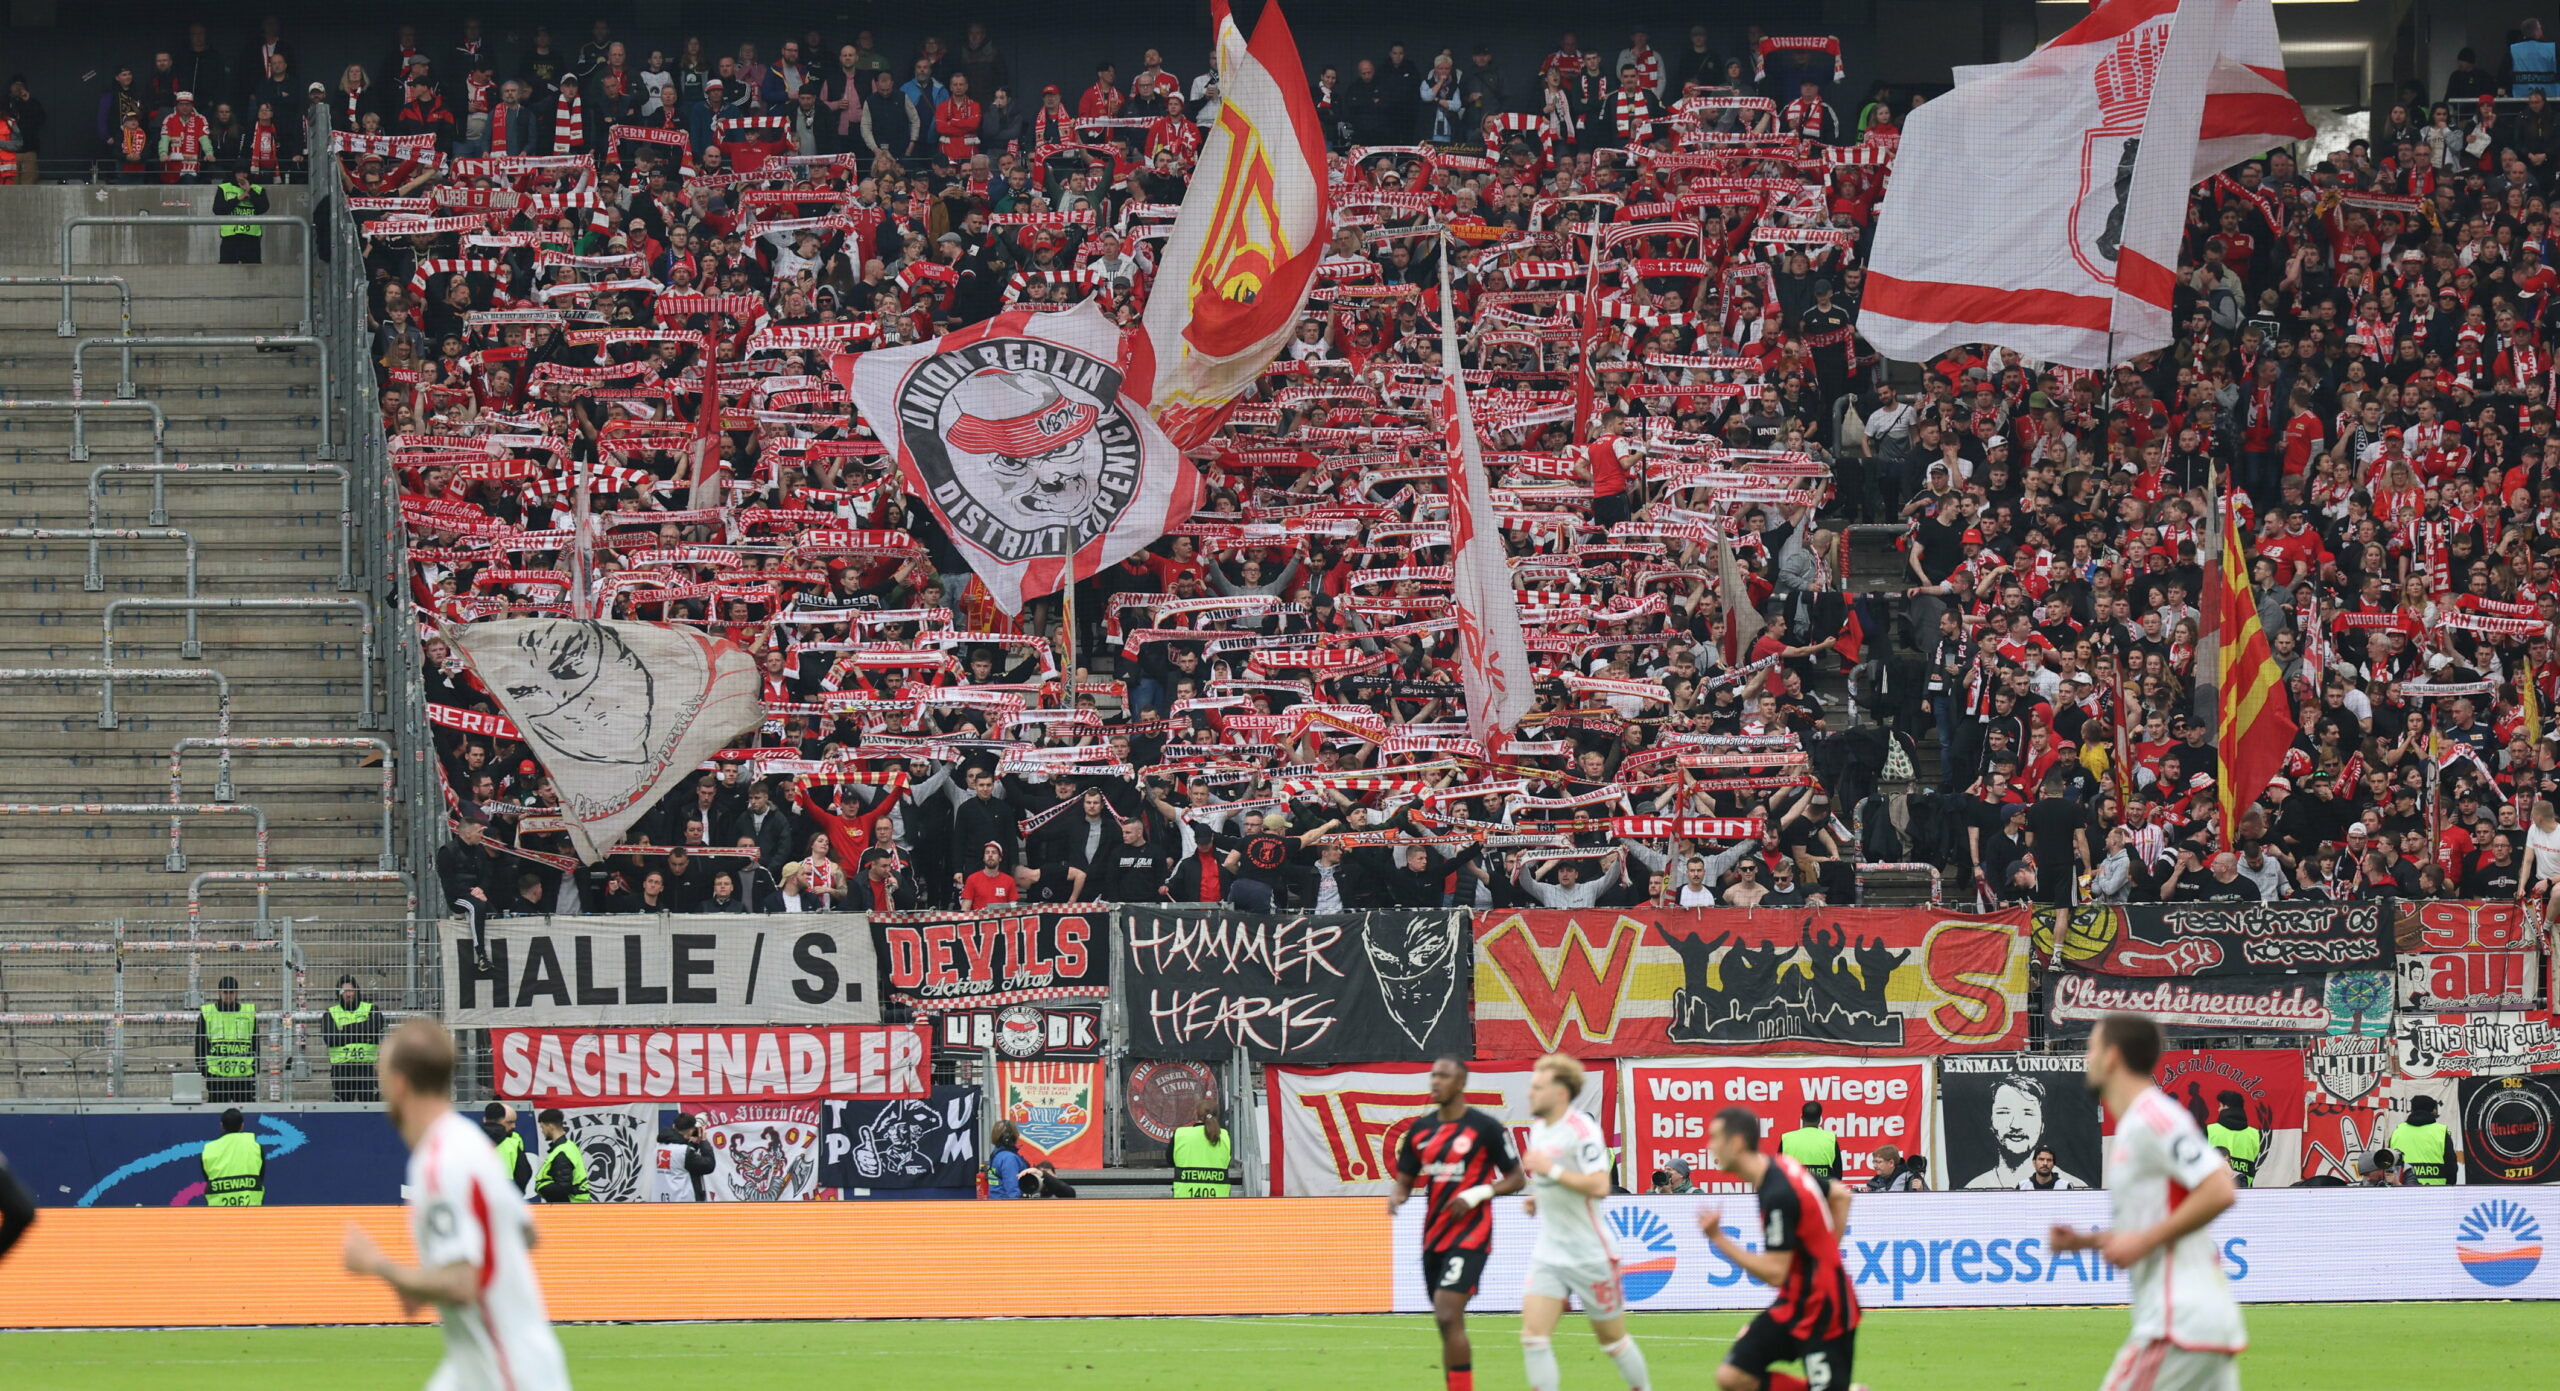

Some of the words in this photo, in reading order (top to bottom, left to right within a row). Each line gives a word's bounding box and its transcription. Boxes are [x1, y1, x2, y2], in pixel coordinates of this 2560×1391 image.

[1771, 36, 1828, 49] UNIONER
[1446, 156, 1454, 165] FC
[1455, 156, 1477, 167] UNION
[1654, 157, 1717, 168] WALDSEITE
[752, 192, 780, 203] SPIELT
[1681, 194, 1723, 206] EISERN
[1724, 193, 1760, 205] UNION
[374, 221, 430, 233] EISERN
[434, 215, 482, 230] UNION
[816, 215, 844, 228] 1966
[1658, 261, 1665, 272] 1.
[1670, 262, 1684, 273] FC
[902, 349, 972, 430] UNION
[977, 343, 1105, 393] BERLIN
[1631, 387, 1638, 395] 1.
[1644, 385, 1658, 395] FC
[1663, 385, 1701, 395] Union
[1706, 384, 1741, 395] Berlin
[402, 434, 448, 447] EISERN
[450, 437, 489, 450] UNION
[1239, 453, 1298, 464] UNIONER
[1329, 458, 1365, 470] EISERN
[933, 479, 1066, 560] DISTRIKT
[1305, 519, 1334, 532] SEIT
[491, 570, 512, 580] FÜR
[652, 587, 691, 599] UNION
[1192, 599, 1225, 607] UNION
[1226, 597, 1263, 606] BERLIN
[2478, 599, 2534, 615] UNIONER
[1206, 609, 1243, 621] UNION
[1546, 609, 1581, 622] 1966
[2345, 614, 2397, 627] UNIONER
[2477, 616, 2529, 633] UNION
[1219, 638, 1258, 650] UNION
[1584, 635, 1630, 646] SCHULTER
[1124, 720, 1171, 733] Berlin
[1229, 716, 1273, 727] EISERN
[1166, 746, 1204, 756] UNION
[1233, 746, 1276, 756] BERLIN
[1720, 755, 1749, 764] UNION
[1201, 772, 1240, 785] UNION
[1270, 765, 1314, 777] BERLIN
[1623, 819, 1753, 837] UNION
[886, 915, 1091, 988] DEVILS
[1128, 916, 1346, 986] HAMMER
[456, 934, 717, 1010] HALLE
[745, 932, 765, 1004] /
[791, 931, 862, 1003] S.
[921, 974, 995, 997] Action
[1476, 914, 1647, 1053] W
[1922, 920, 2018, 1045] S
[2053, 973, 2326, 1020] Oberschöneweide
[1149, 987, 1338, 1056] HEARTS
[2197, 1015, 2228, 1026] Unions
[2260, 1019, 2274, 1028] seit
[2275, 1018, 2298, 1029] 1906
[946, 1013, 995, 1049] UB
[1047, 1013, 1095, 1048] DK
[2418, 1025, 2464, 1050] EINS
[2464, 1016, 2512, 1054] FÜNF
[2318, 1035, 2379, 1055] Sektion
[343, 1047, 366, 1061] 746
[2517, 1052, 2540, 1067] UNION
[216, 1060, 248, 1075] 1876
[502, 1031, 926, 1098] SACHSENADLER
[1944, 1057, 2014, 1074] EINMAL
[2313, 1055, 2388, 1074] PLATTE
[1134, 1064, 1153, 1081] DIE
[1156, 1071, 1188, 1086] EISERN
[1161, 1081, 1197, 1095] UNION
[1649, 1077, 1714, 1101] Von
[1724, 1076, 1784, 1101] der
[1800, 1075, 1909, 1106] Wiege
[1652, 1113, 1704, 1138] bis
[825, 1132, 850, 1165] P
[1180, 1170, 1225, 1182] STEWARD
[211, 1176, 258, 1192] STEWARD
[1188, 1187, 1217, 1198] 1409
[1447, 1256, 1466, 1283] 3
